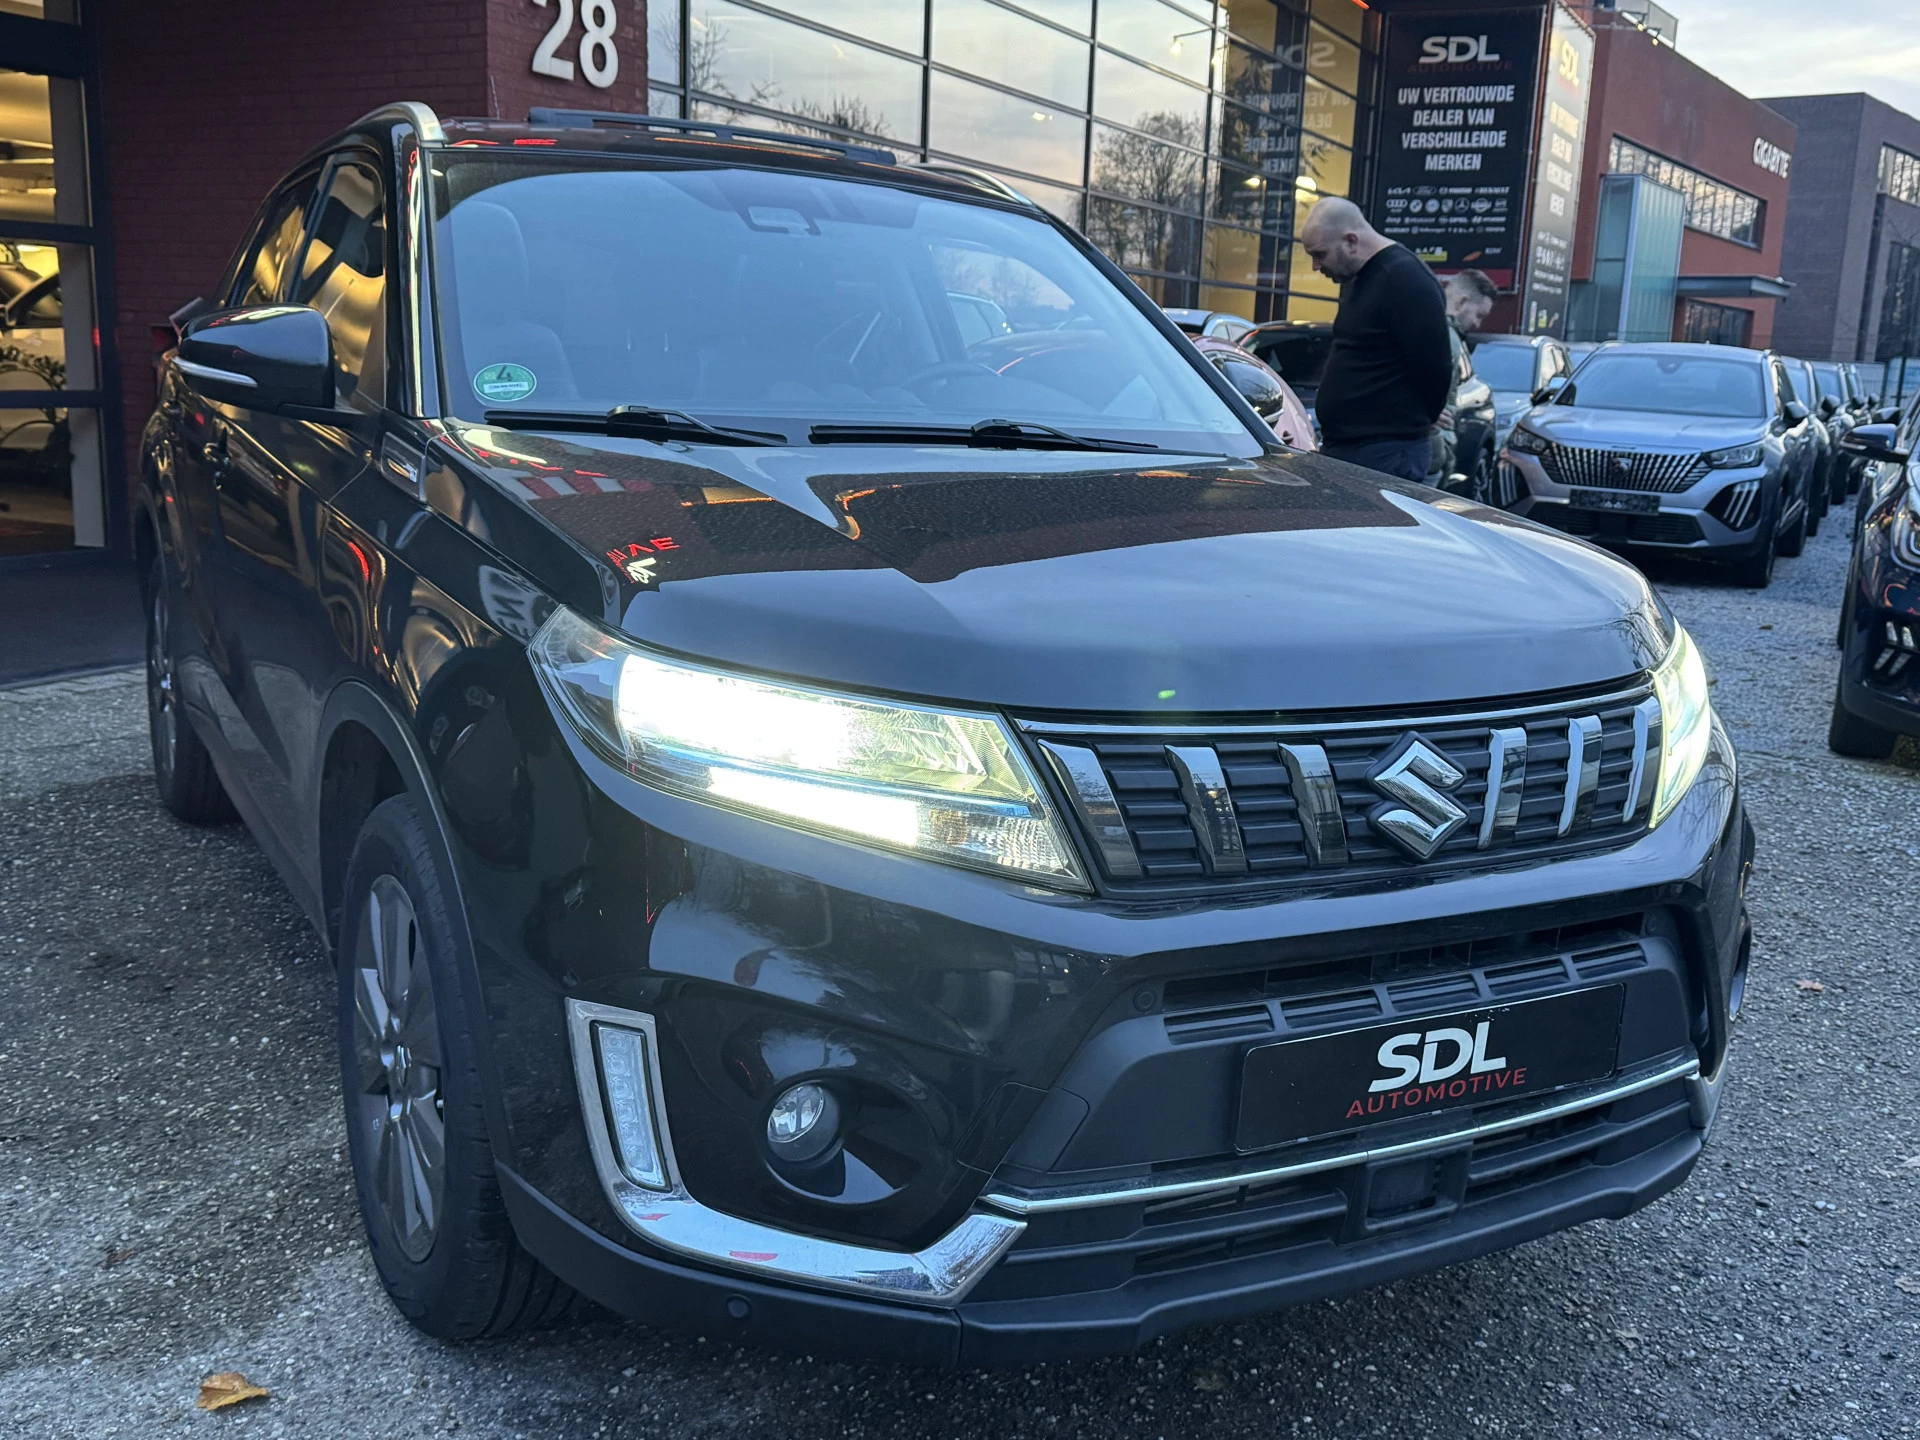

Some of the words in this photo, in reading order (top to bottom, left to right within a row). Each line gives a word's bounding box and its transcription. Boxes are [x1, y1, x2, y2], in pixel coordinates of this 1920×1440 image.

[532, 0, 619, 88] 28
[1418, 35, 1500, 64] SDL
[1407, 60, 1514, 73] AUTOMOTIVE
[1398, 88, 1421, 105] UW
[1423, 85, 1515, 104] VERTROUWDE
[1413, 109, 1464, 126] DEALER
[1467, 108, 1495, 125] VAN
[1401, 130, 1507, 149] VERSCHILLENDE
[1424, 154, 1482, 171] MERKEN
[496, 365, 514, 382] 4
[1367, 1022, 1506, 1092] SDL
[1345, 1067, 1527, 1118] AUTOMOTIVE
